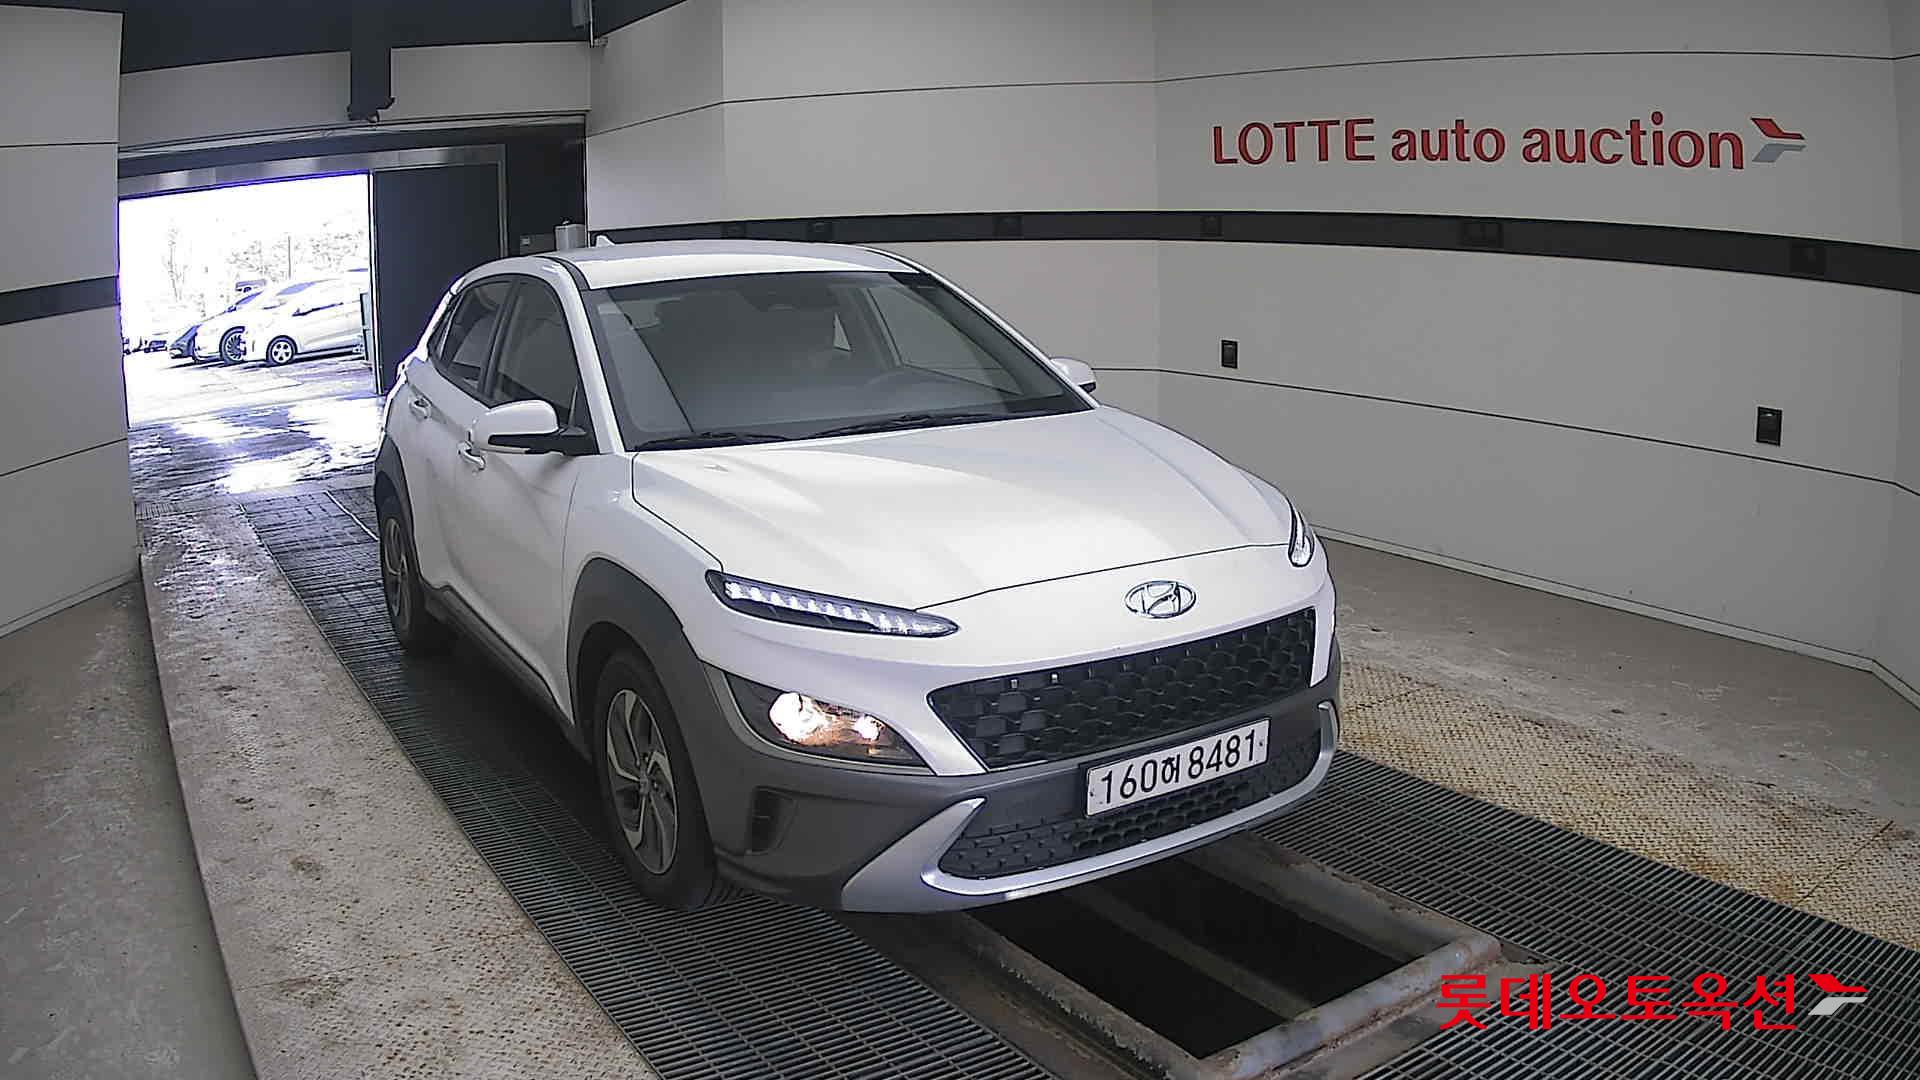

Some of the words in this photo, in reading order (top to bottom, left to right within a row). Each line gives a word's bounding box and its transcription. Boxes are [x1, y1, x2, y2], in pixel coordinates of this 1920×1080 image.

[1212, 117, 1376, 166] LOTTE
[1391, 119, 1507, 163] auto
[1522, 111, 1746, 170] auction
[1101, 754, 1181, 804] 160허
[1188, 728, 1256, 780] 8481
